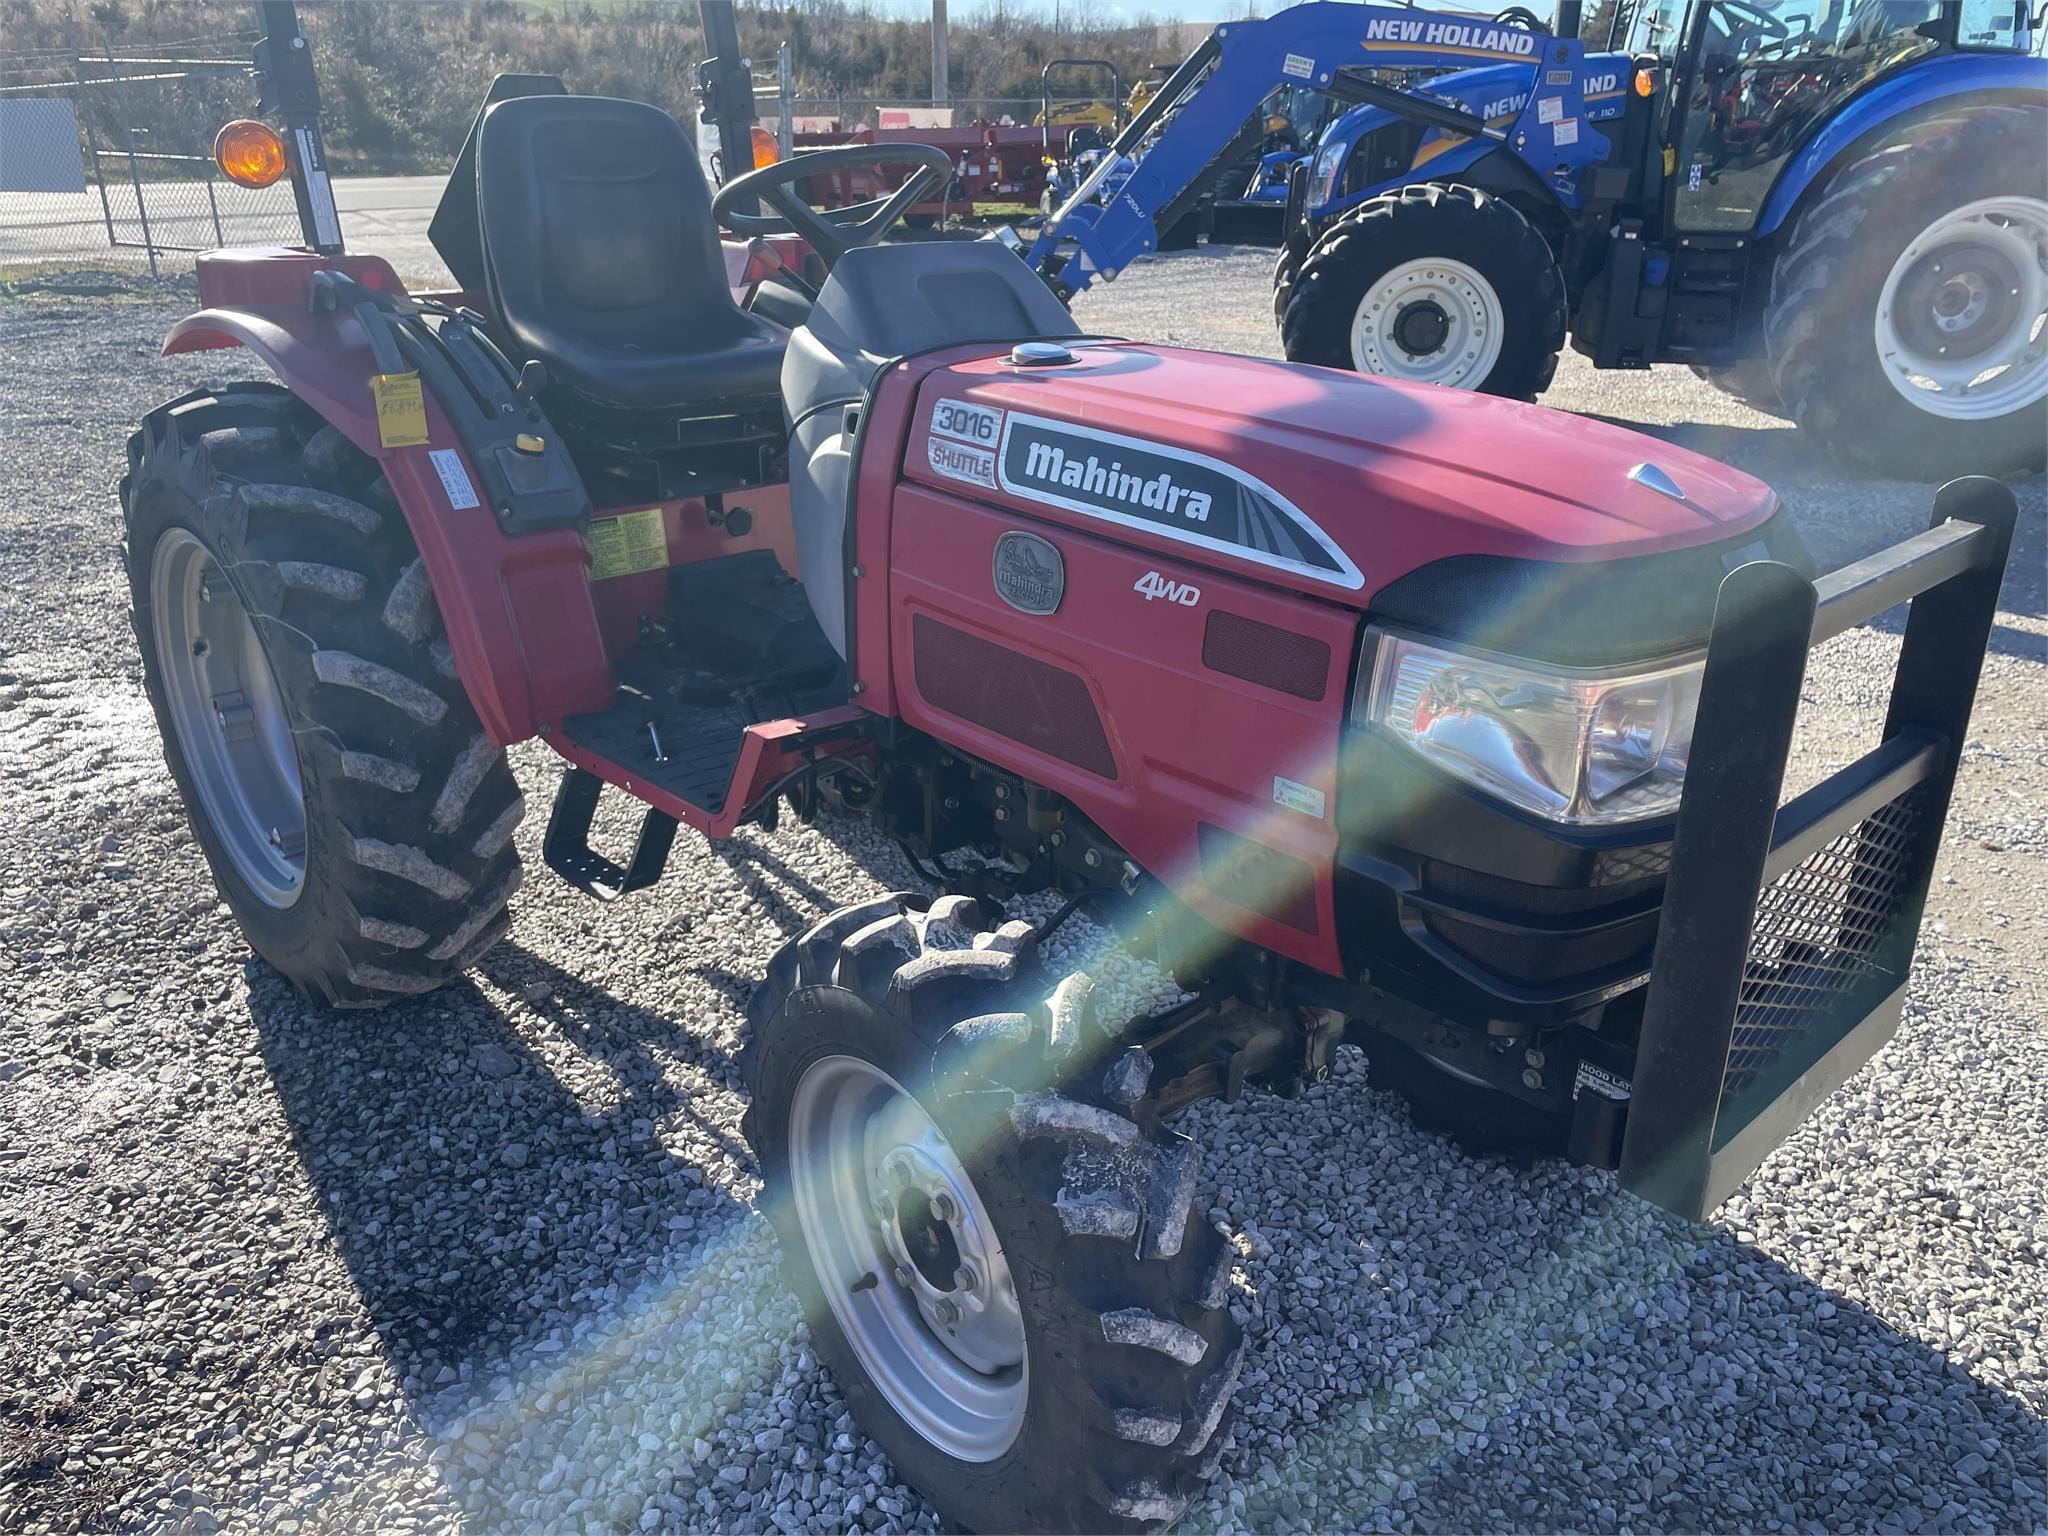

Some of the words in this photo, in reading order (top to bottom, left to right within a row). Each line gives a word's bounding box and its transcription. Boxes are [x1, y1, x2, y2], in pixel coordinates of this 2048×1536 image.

[1366, 19, 1424, 42] NEW
[1424, 22, 1534, 55] HOLLAND
[1483, 93, 1527, 120] NEW
[939, 406, 995, 440] 3016
[933, 446, 992, 477] SHUTTLE
[1025, 442, 1212, 522] Mahindra
[1000, 569, 1054, 600] Mahindra
[1134, 571, 1201, 607] 4WD
[1580, 1062, 1609, 1081] HOOD
